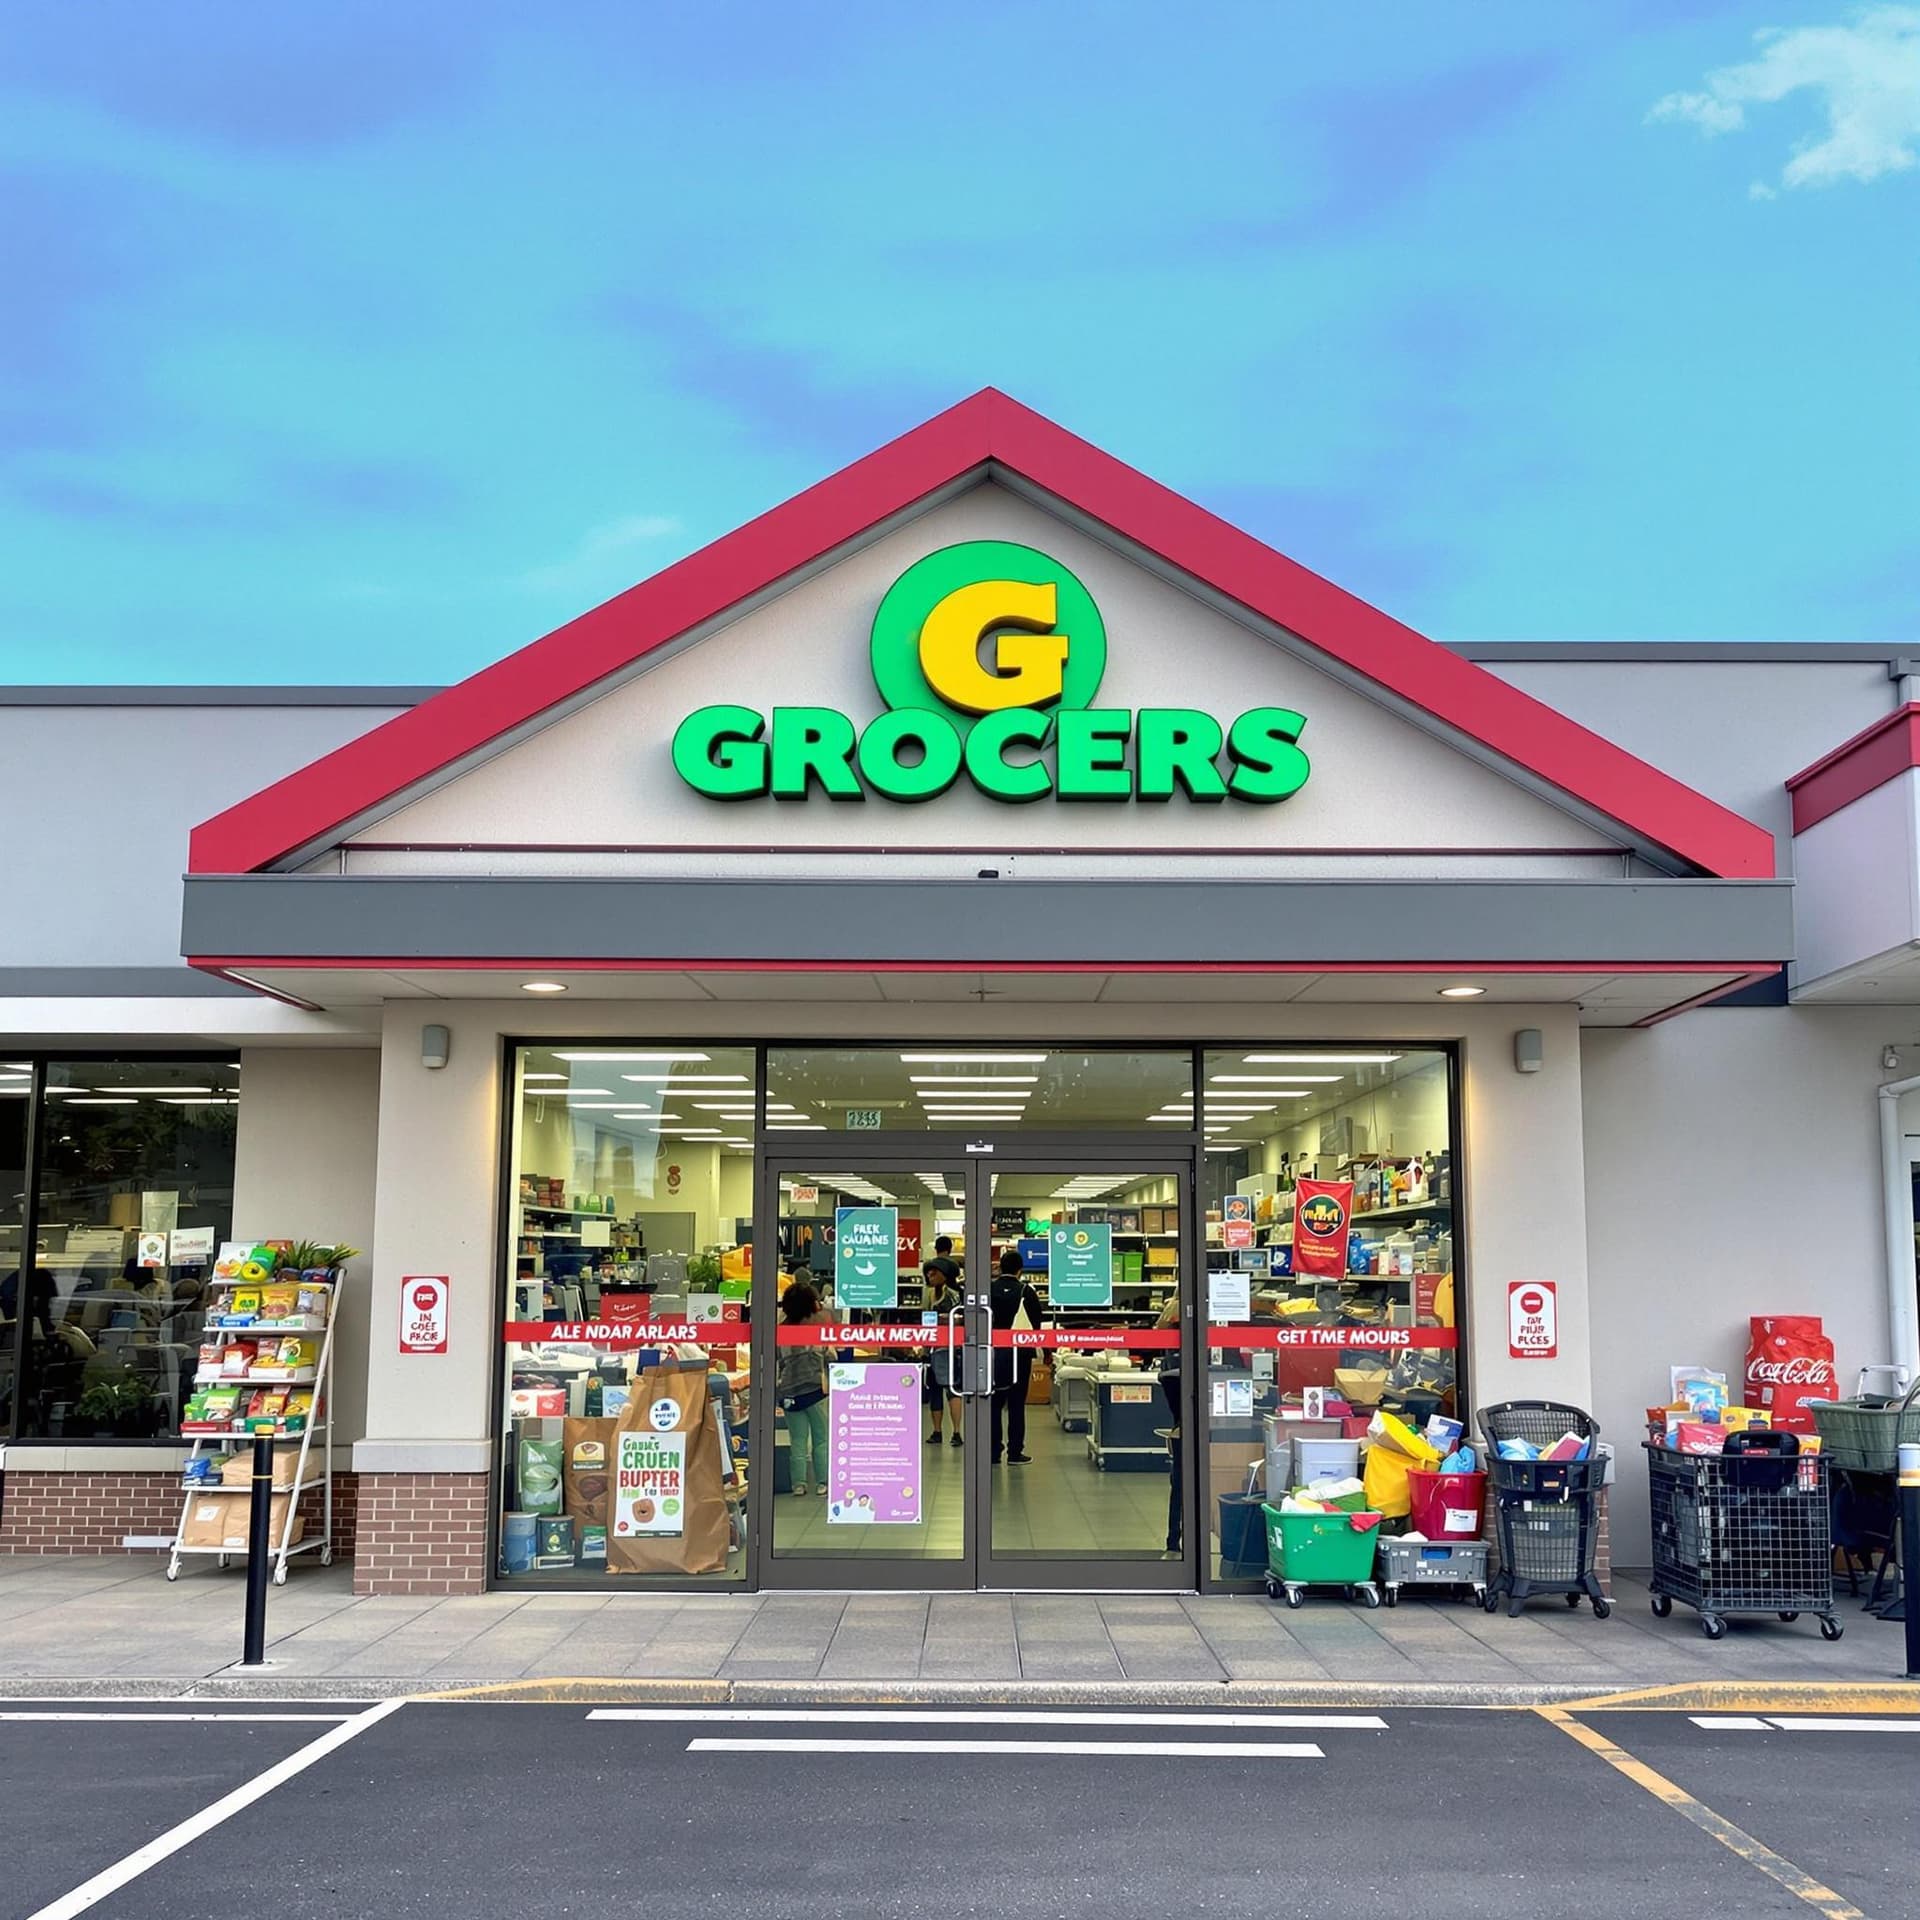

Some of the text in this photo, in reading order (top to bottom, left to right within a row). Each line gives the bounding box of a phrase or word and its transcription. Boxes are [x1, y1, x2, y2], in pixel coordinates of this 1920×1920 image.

[918, 579, 1070, 714] G
[671, 704, 1311, 803] GROCERS
[550, 1325, 697, 1340] ALE NDAR ARLARS
[1277, 1330, 1410, 1344] GET TME MOURS
[623, 1451, 680, 1469] CRUEN
